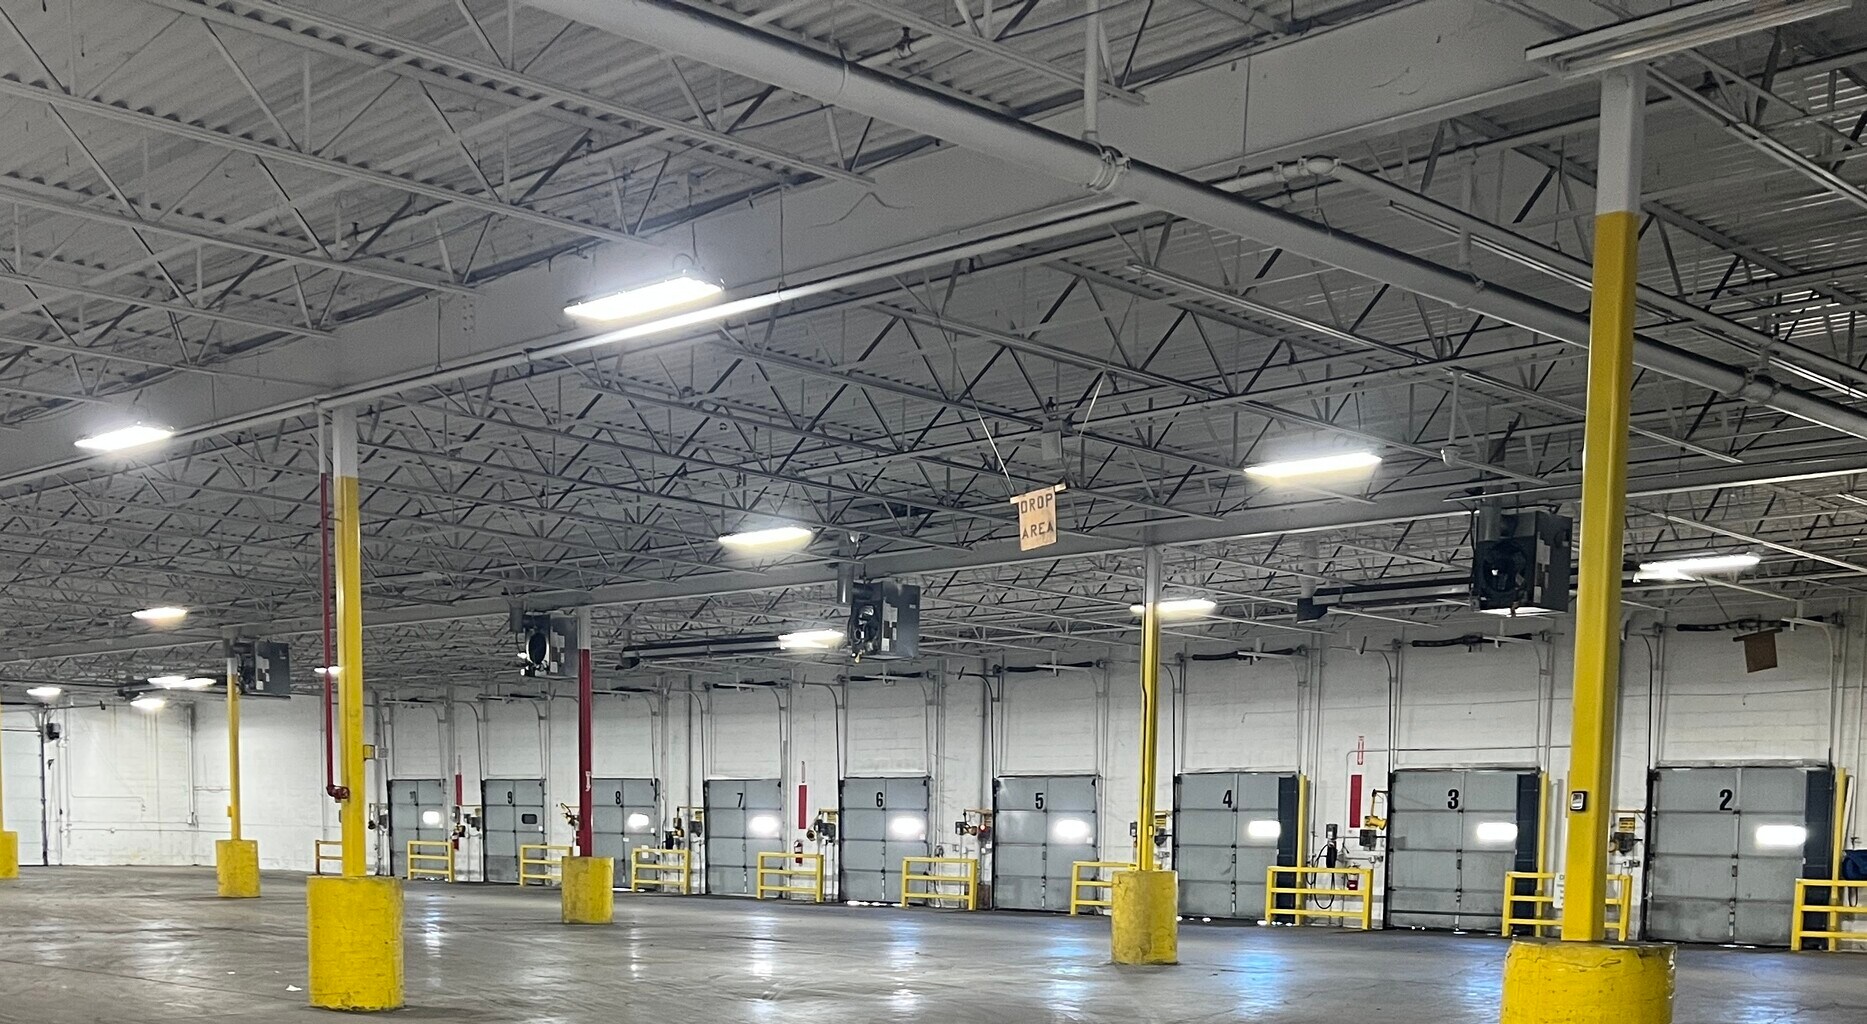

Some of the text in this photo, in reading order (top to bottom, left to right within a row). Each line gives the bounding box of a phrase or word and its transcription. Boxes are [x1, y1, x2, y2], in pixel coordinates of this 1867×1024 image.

[1021, 493, 1053, 514] DROP
[1022, 521, 1054, 540] AREA
[507, 791, 513, 805] 9
[615, 791, 621, 805] 8
[737, 792, 744, 808] 7
[876, 792, 884, 808] 6
[1035, 792, 1044, 810] 5
[1222, 789, 1233, 809] 4
[1447, 789, 1460, 810] 3
[1719, 789, 1733, 811] 2
